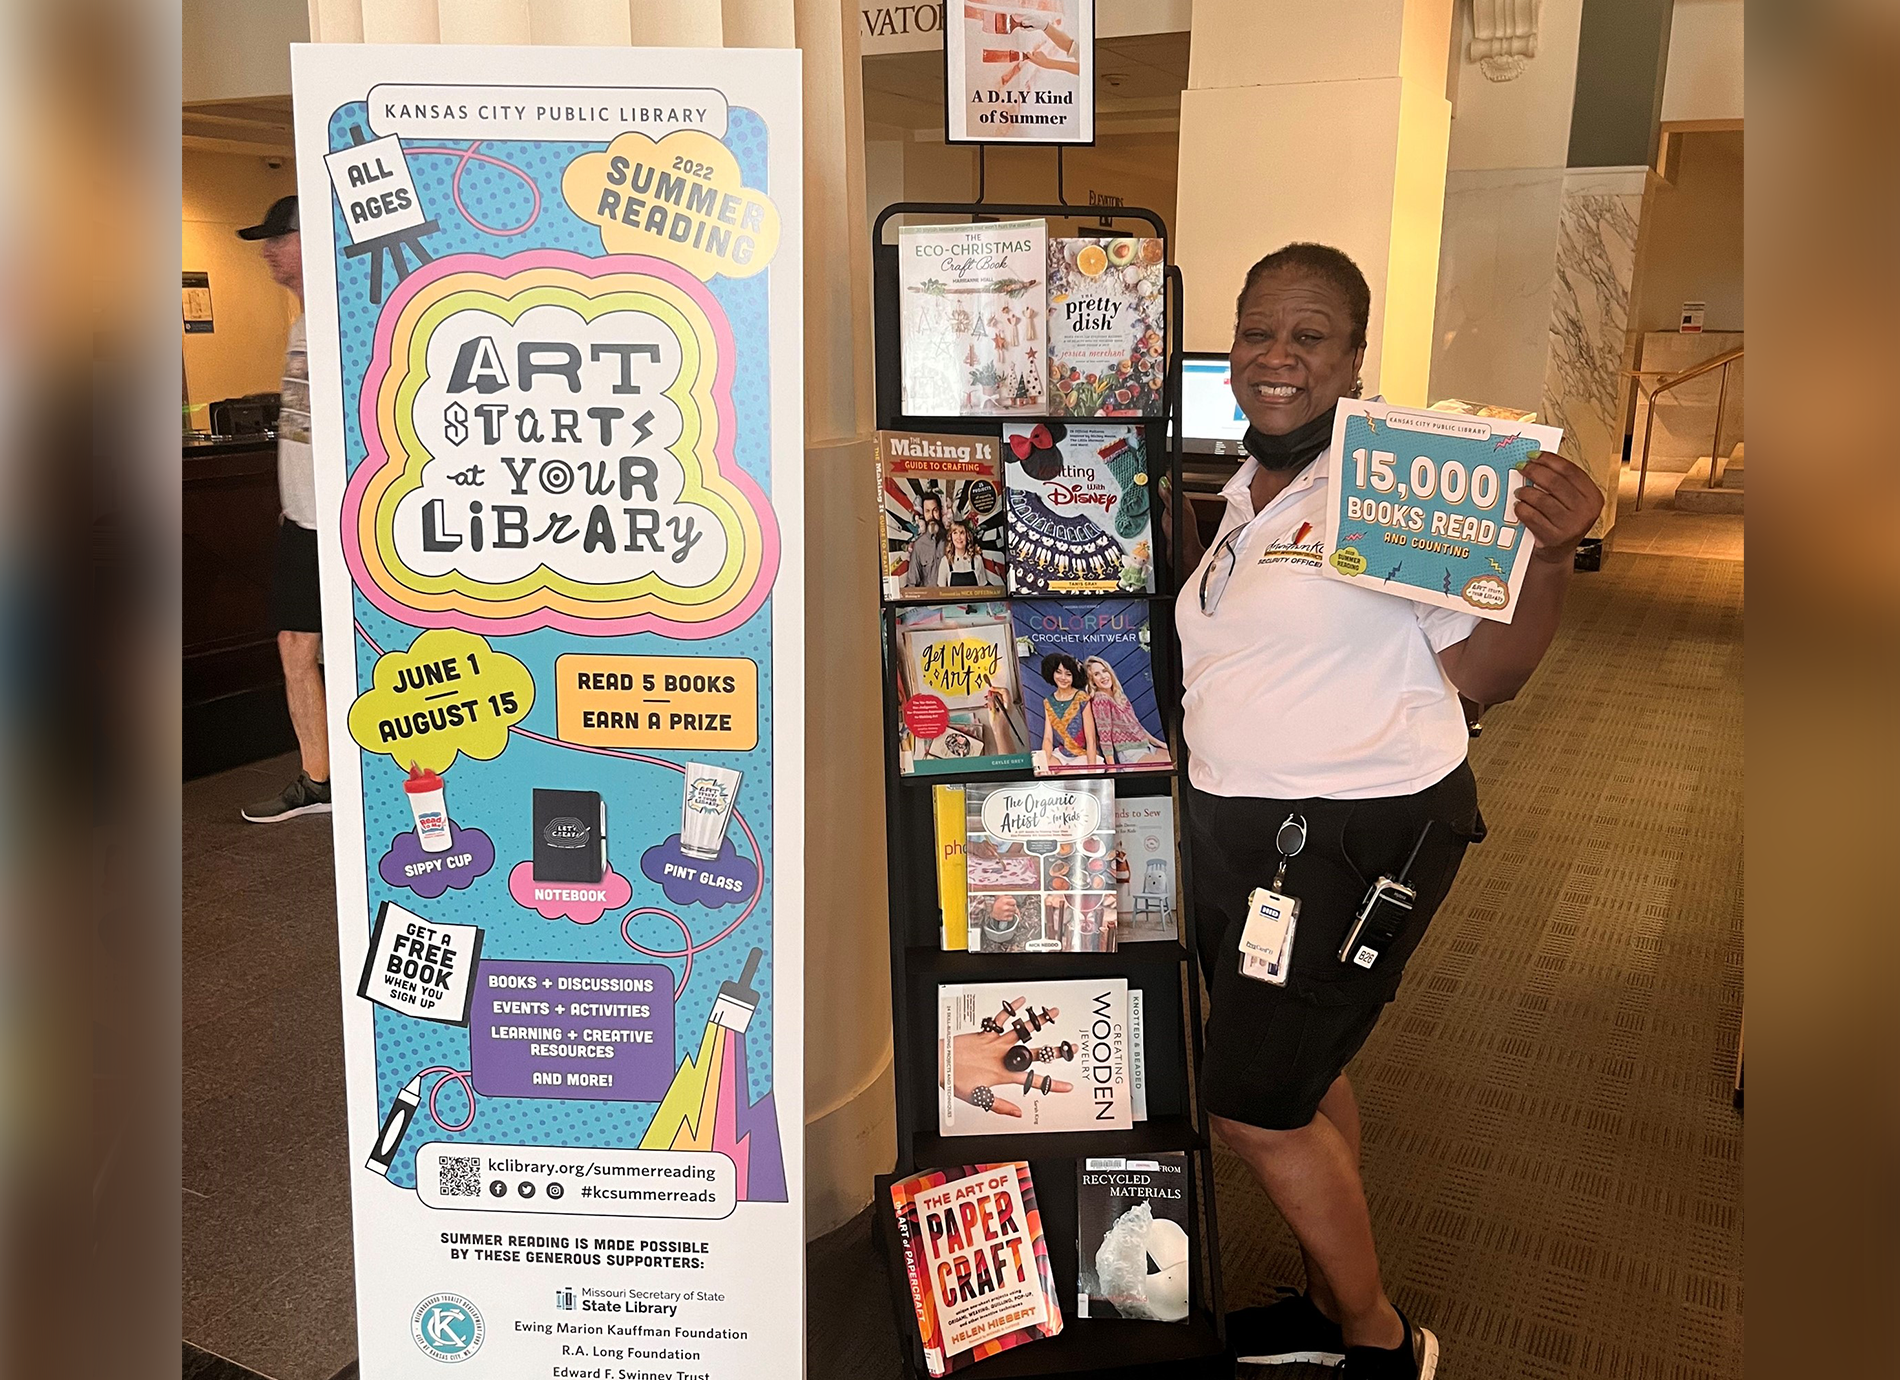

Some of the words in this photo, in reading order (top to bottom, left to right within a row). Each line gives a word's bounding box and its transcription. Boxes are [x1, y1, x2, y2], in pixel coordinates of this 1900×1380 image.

[861, 3, 944, 36] VATO
[972, 90, 984, 103] A
[988, 90, 1030, 104] D.I.Y
[1035, 91, 1073, 105] Kind
[384, 104, 468, 120] KANSAS
[478, 105, 526, 121] CITY
[536, 106, 609, 122] PUBLIC
[619, 107, 709, 124] LIBRARY
[979, 110, 996, 124] of
[999, 111, 1067, 126] Summer
[346, 158, 394, 188] ALL
[672, 155, 715, 181] 2022
[350, 187, 412, 224] AGES
[605, 156, 766, 234] SUMMER
[597, 186, 756, 267] READING
[965, 234, 982, 242] THE
[916, 240, 1032, 257] ECO-CHRISTMAS
[940, 257, 974, 279] Craft
[976, 255, 1008, 270] Book
[1066, 297, 1122, 320] pretty
[1072, 312, 1113, 333] dish
[446, 335, 661, 395] ART
[1390, 417, 1414, 426] KANSAS
[1416, 420, 1430, 428] CITY
[1433, 422, 1454, 432] PUBLIC
[1457, 426, 1486, 435] LIBRARY
[890, 438, 971, 462] Making
[975, 442, 992, 460] It
[446, 464, 485, 488] at
[904, 460, 928, 470] GUIDE
[930, 462, 940, 470] TO
[942, 462, 980, 472] CRAFTING
[1351, 448, 1499, 510] 15,000
[1347, 496, 1424, 533] BOOKS
[1384, 532, 1407, 546] AND
[1411, 538, 1470, 560] COUNTING
[1029, 614, 1136, 630] COLORFUL
[1032, 633, 1080, 642] CROCHET
[1082, 633, 1136, 642] KNITWEAR
[392, 658, 461, 694] JUNE
[466, 653, 482, 676] 1
[578, 672, 634, 691] READ
[642, 674, 656, 692] 5
[664, 674, 736, 694] BOOKS
[378, 700, 480, 743] AUGUST
[488, 691, 519, 718] 15
[582, 712, 640, 730] EARN
[647, 712, 660, 730] A
[670, 713, 732, 732] PRIZE
[1003, 796, 1023, 811] The
[1025, 793, 1076, 818] Organic
[1132, 810, 1142, 818] to
[1144, 808, 1161, 818] Sew
[1000, 812, 1041, 833] Artist
[404, 858, 444, 878] SIPPY
[447, 853, 473, 870] CUP
[664, 863, 696, 881] PINT
[699, 870, 744, 892] GLASS
[534, 888, 607, 902] NOTEBOOK
[406, 922, 436, 942] GET
[440, 933, 452, 946] A
[392, 934, 458, 970] FREE
[1358, 950, 1374, 964] B26
[386, 955, 454, 990] BOOK
[488, 975, 538, 990] BOOKS
[542, 978, 552, 989] +
[558, 976, 654, 993] DISCUSSIONS
[383, 974, 418, 994] WHEN
[420, 984, 444, 1000] YOU
[390, 990, 416, 1006] SIGN
[418, 996, 436, 1010] UP
[492, 1001, 550, 1016] EVENTS
[554, 1004, 566, 1015] +
[570, 1003, 651, 1018] ACTIVITIES
[1132, 996, 1140, 1040] KNOTTED
[491, 1027, 563, 1042] LEARNING
[567, 1030, 578, 1040] +
[582, 1028, 654, 1044] CREATIVE
[530, 1044, 615, 1060] RESOURCES
[1079, 1029, 1091, 1081] JEWELRY
[1092, 992, 1116, 1120] WOODEN
[1113, 1023, 1124, 1085] CREATING
[532, 1072, 563, 1086] AND
[566, 1072, 614, 1088] MORE!
[1134, 1051, 1142, 1090] BEADED
[488, 1158, 716, 1181] kclibrary.org/summerreading
[1082, 1174, 1151, 1185] RECYCLED
[1158, 1165, 1181, 1174] FROM
[580, 1186, 716, 1204] #kcsummerreads
[924, 1192, 952, 1212] THE
[955, 1182, 986, 1202] ART
[988, 1176, 1010, 1192] OF
[1110, 1186, 1182, 1200] MATERIALS
[926, 1190, 1020, 1260] PAPER
[440, 1232, 503, 1246] SUMMER
[508, 1235, 570, 1249] READING
[574, 1238, 589, 1250] IS
[594, 1238, 635, 1252] MADE
[640, 1240, 710, 1254] POSSIBLE
[450, 1248, 470, 1260] BY
[474, 1250, 521, 1262] THESE
[526, 1252, 601, 1266] GENEROUS
[606, 1254, 706, 1270] SUPPORTERS:
[898, 1218, 909, 1238] ART
[904, 1250, 926, 1323] PAPERCRAFT
[936, 1236, 1026, 1308] CRAFT
[581, 1286, 626, 1299] Missouri
[628, 1288, 678, 1303] Secretary
[682, 1290, 694, 1302] of
[696, 1291, 726, 1303] State
[582, 1299, 622, 1314] State
[624, 1300, 678, 1318] Library
[514, 1322, 553, 1336] Ewing
[556, 1323, 604, 1336] Marion
[607, 1324, 671, 1338] Kauffman
[674, 1326, 748, 1341] Foundation
[952, 1322, 986, 1344] HELEN
[987, 1306, 1036, 1330] HIEBERT
[562, 1345, 588, 1357] R.A.
[592, 1346, 624, 1361] Long
[627, 1347, 701, 1362] Foundation
[553, 1367, 600, 1380] Edward
[604, 1369, 615, 1380] F.
[618, 1369, 674, 1380] Swinney
[677, 1371, 710, 1380] Trust
